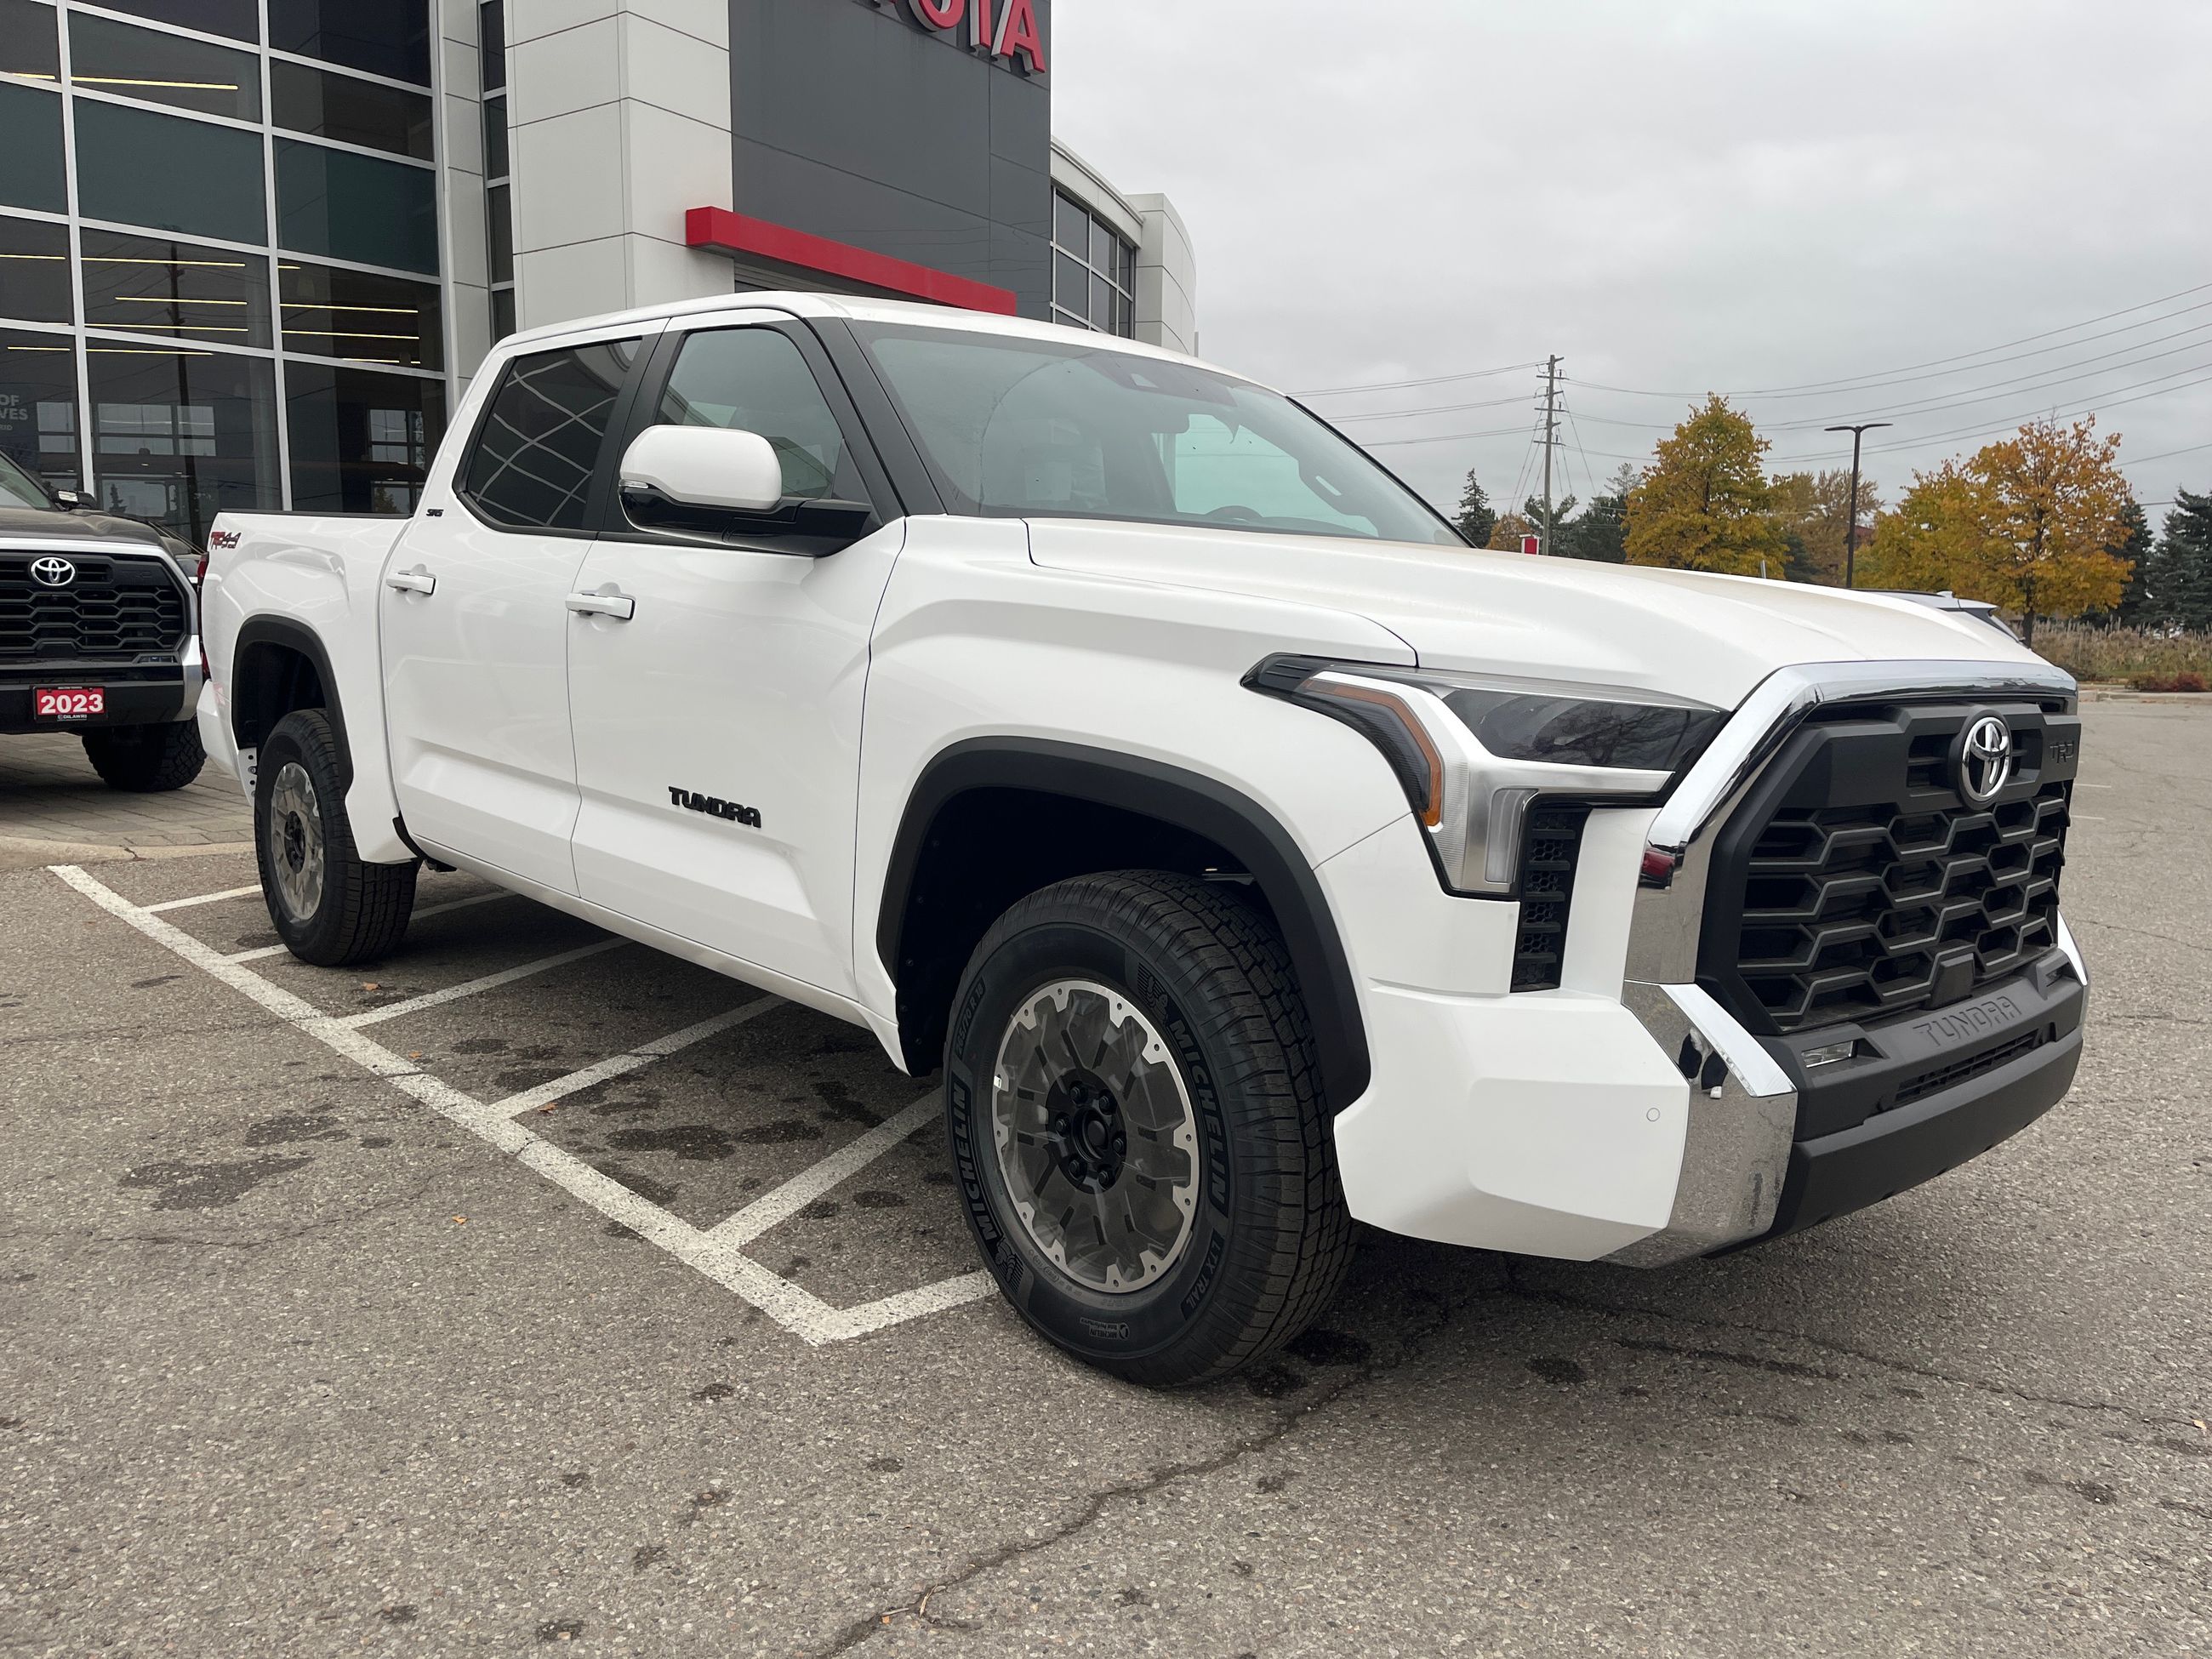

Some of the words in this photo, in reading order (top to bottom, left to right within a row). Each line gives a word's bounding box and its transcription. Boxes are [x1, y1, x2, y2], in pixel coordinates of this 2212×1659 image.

[40, 693, 104, 714] 2023
[668, 785, 761, 828] TUNDRA
[1913, 995, 2022, 1046] TUNDRA
[1169, 1019, 1225, 1205] MICHELIN
[953, 1081, 998, 1241] MICHELIN
[1206, 1240, 1221, 1274] LTX
